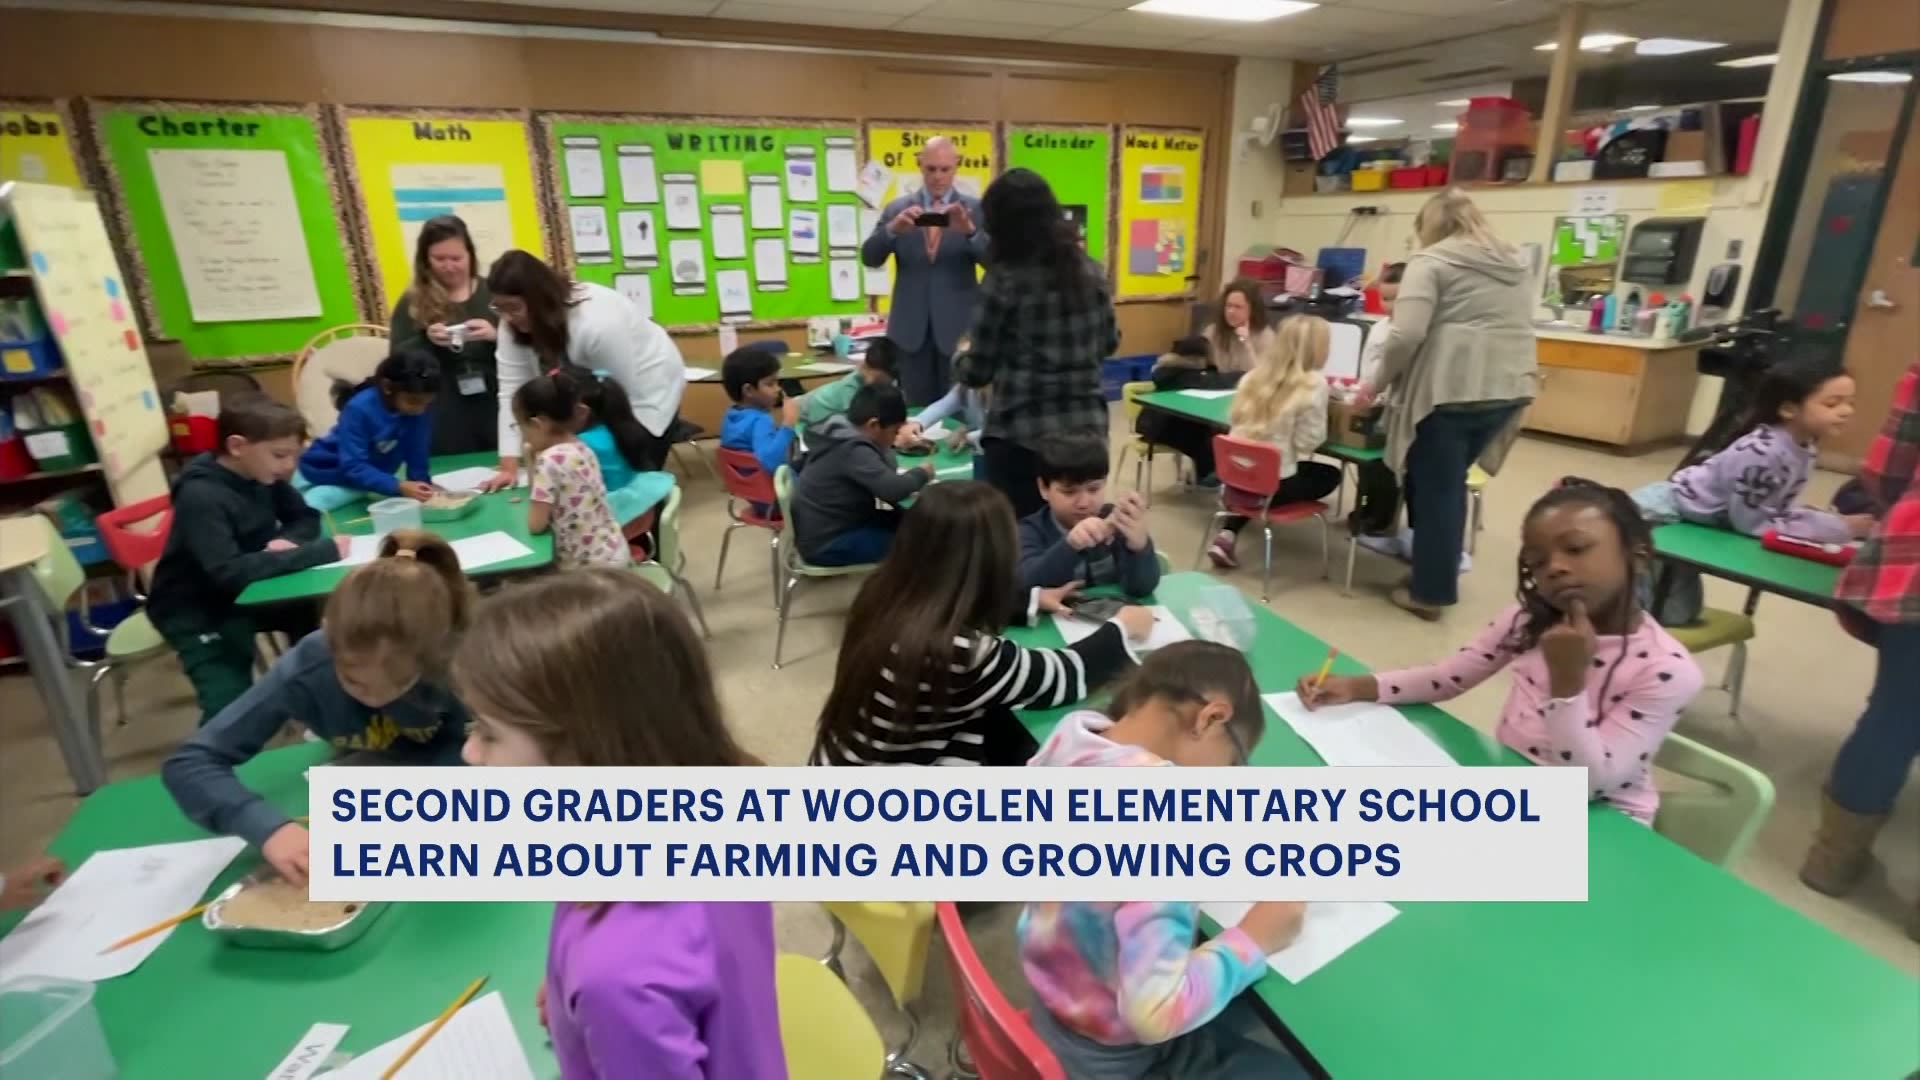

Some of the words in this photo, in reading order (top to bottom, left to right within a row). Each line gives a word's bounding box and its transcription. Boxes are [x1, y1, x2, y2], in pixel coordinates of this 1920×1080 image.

[0, 114, 59, 136] obs
[137, 115, 260, 136] Charter
[413, 121, 471, 141] Math
[667, 133, 775, 152] WRITING
[1125, 134, 1159, 151] Mood
